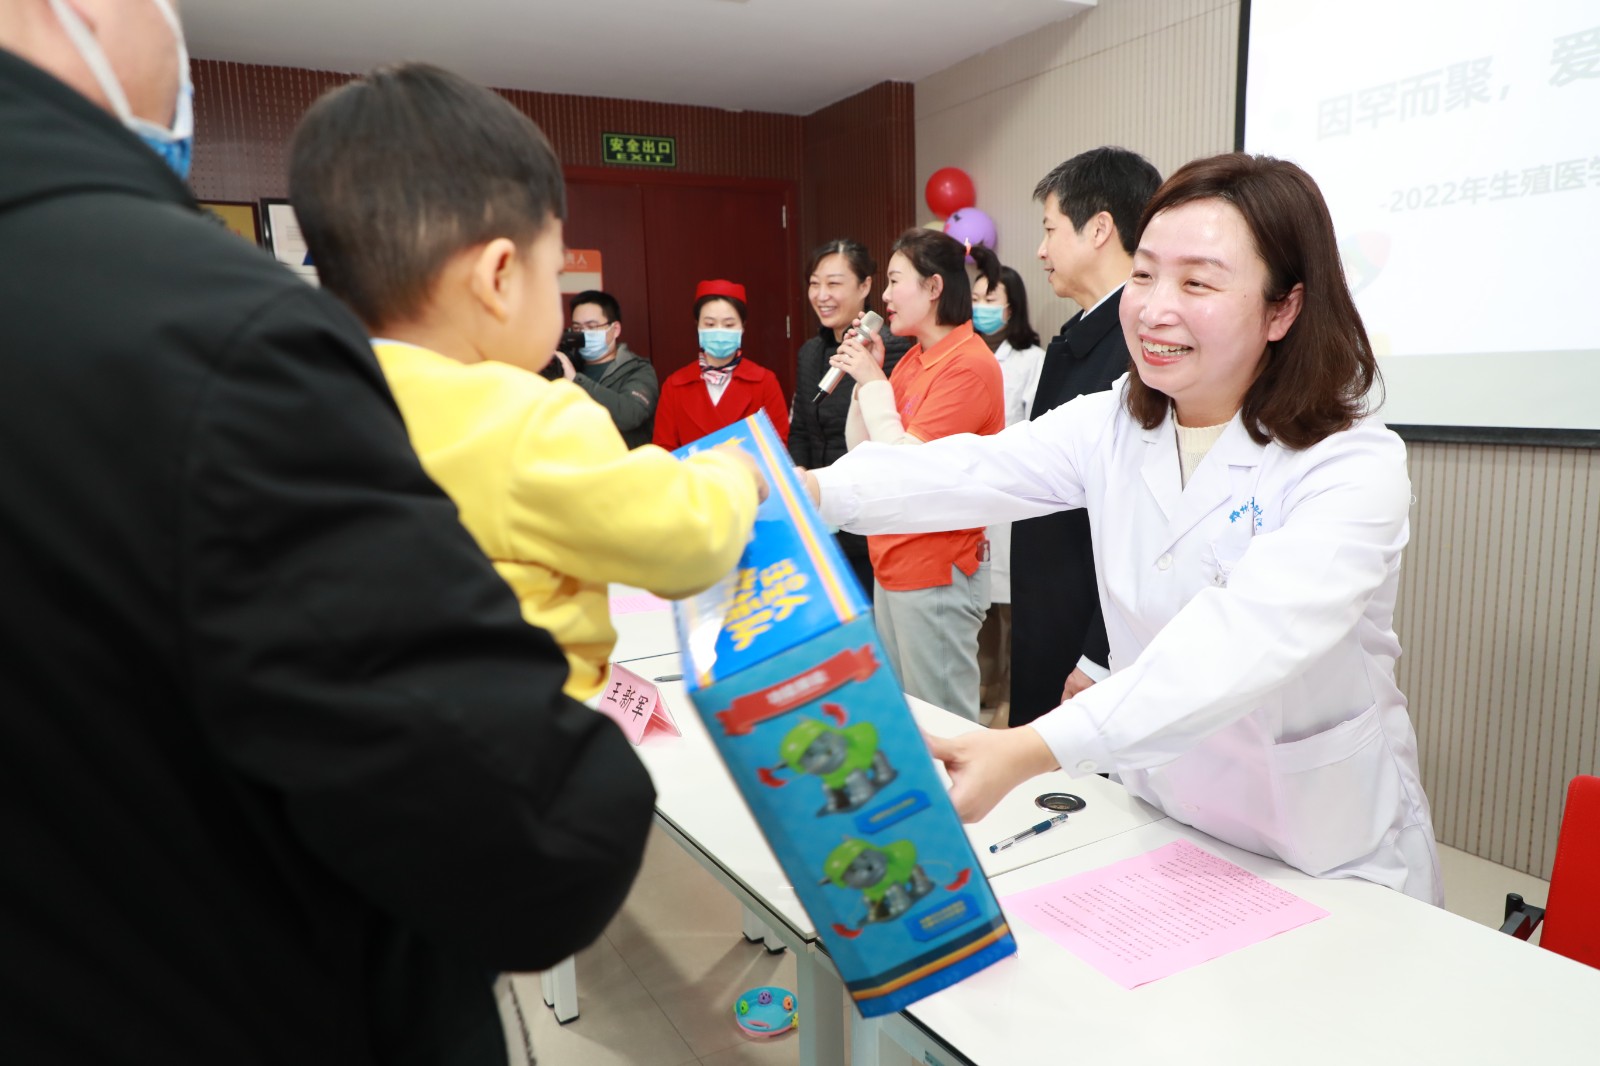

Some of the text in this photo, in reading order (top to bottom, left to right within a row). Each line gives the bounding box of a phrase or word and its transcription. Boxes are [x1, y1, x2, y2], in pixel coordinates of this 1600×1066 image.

[609, 137, 670, 154] 安全出口
[616, 153, 664, 163] EXIT
